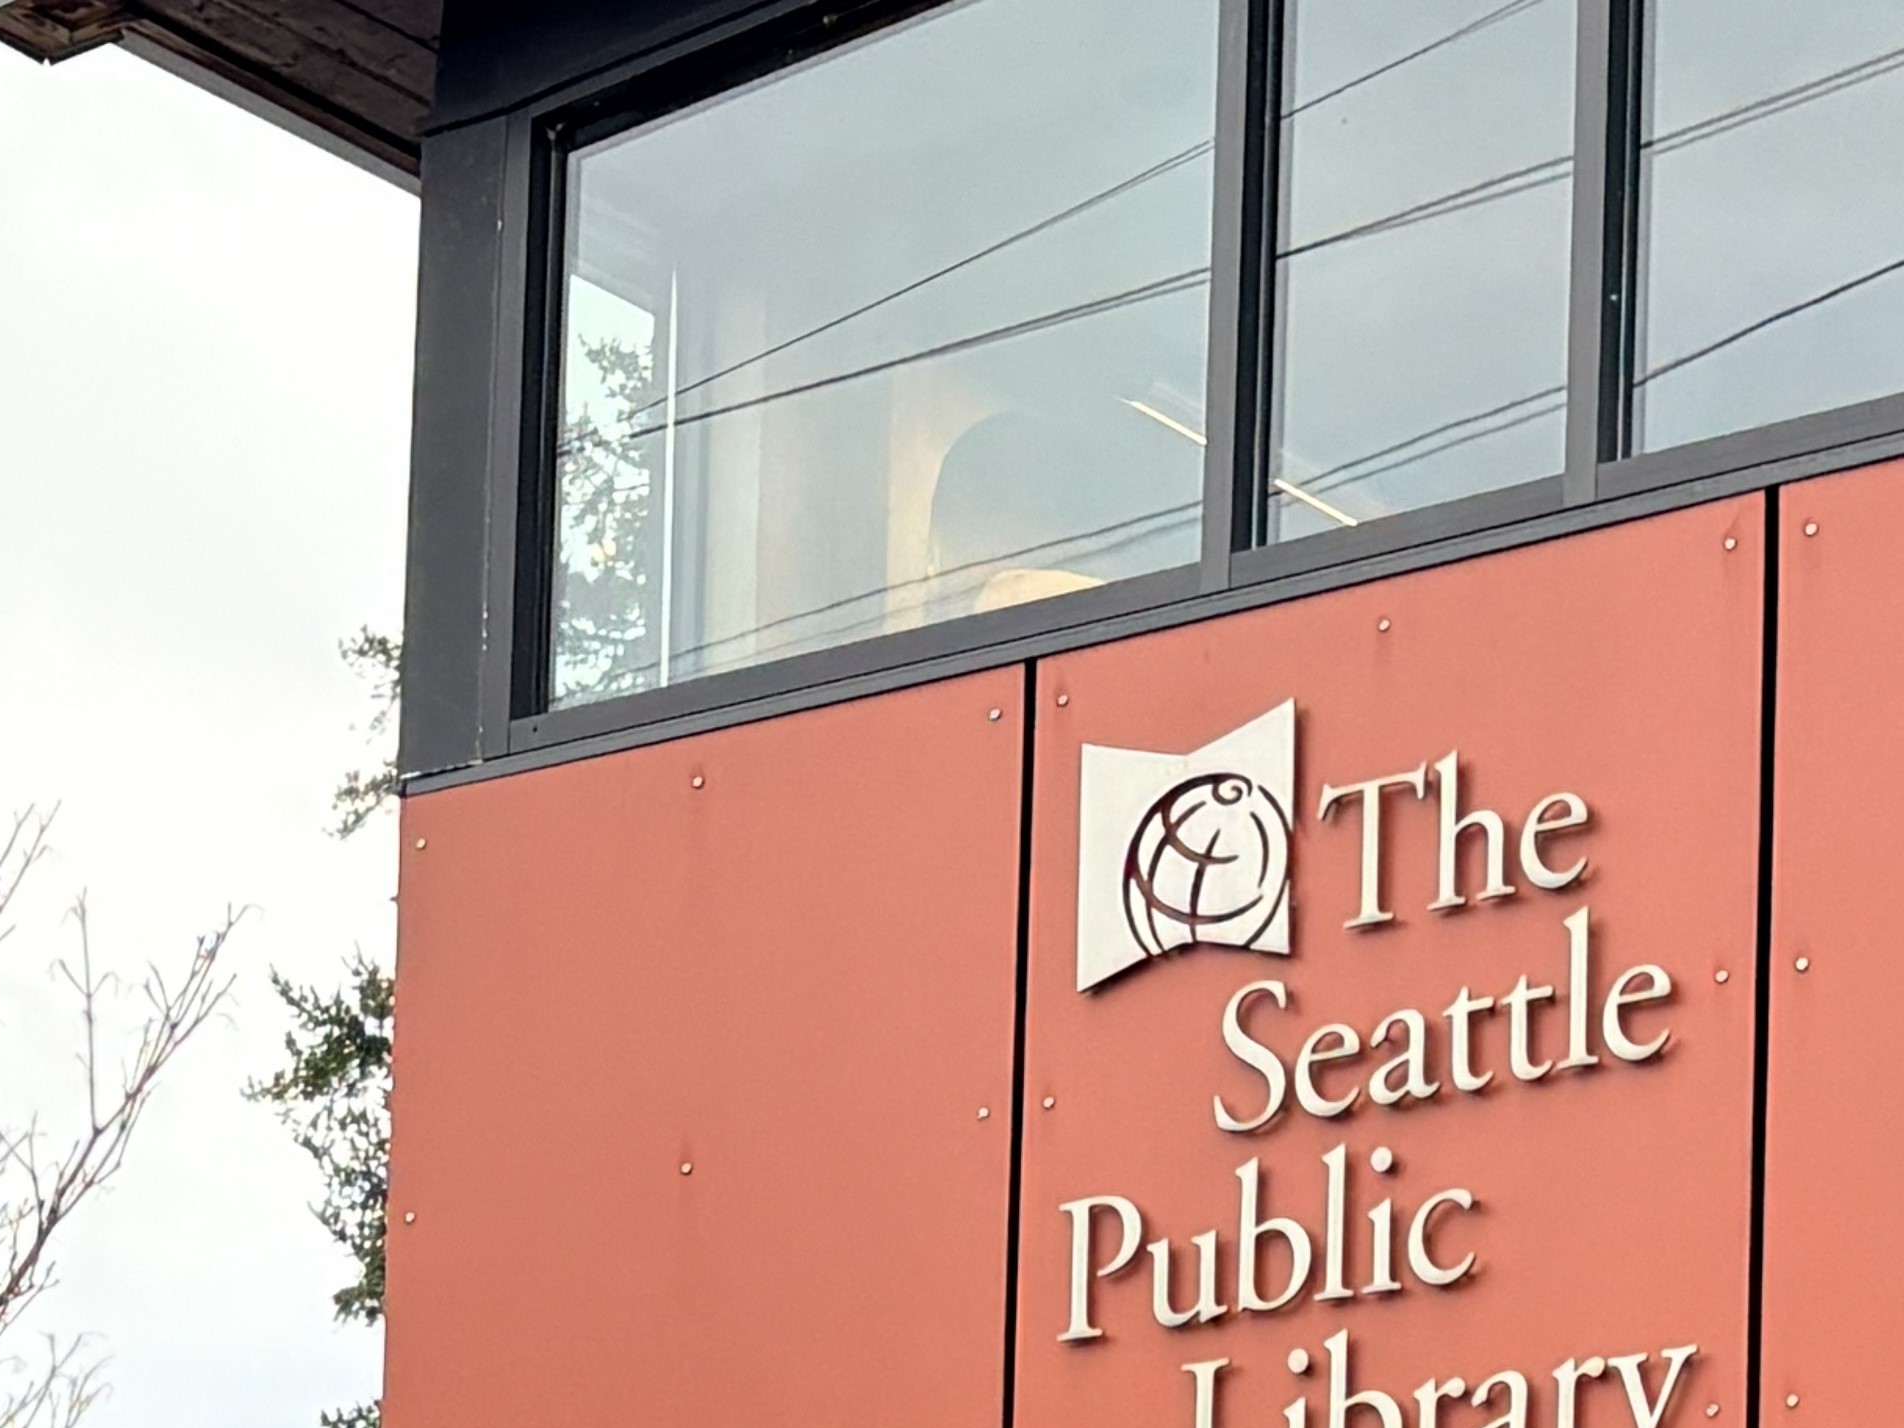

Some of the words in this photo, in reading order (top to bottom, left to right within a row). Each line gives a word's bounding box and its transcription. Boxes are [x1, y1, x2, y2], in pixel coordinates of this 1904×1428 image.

[1316, 748, 1588, 930] The
[1212, 905, 1674, 1134] Seattle
[1056, 1142, 1478, 1343] Public
